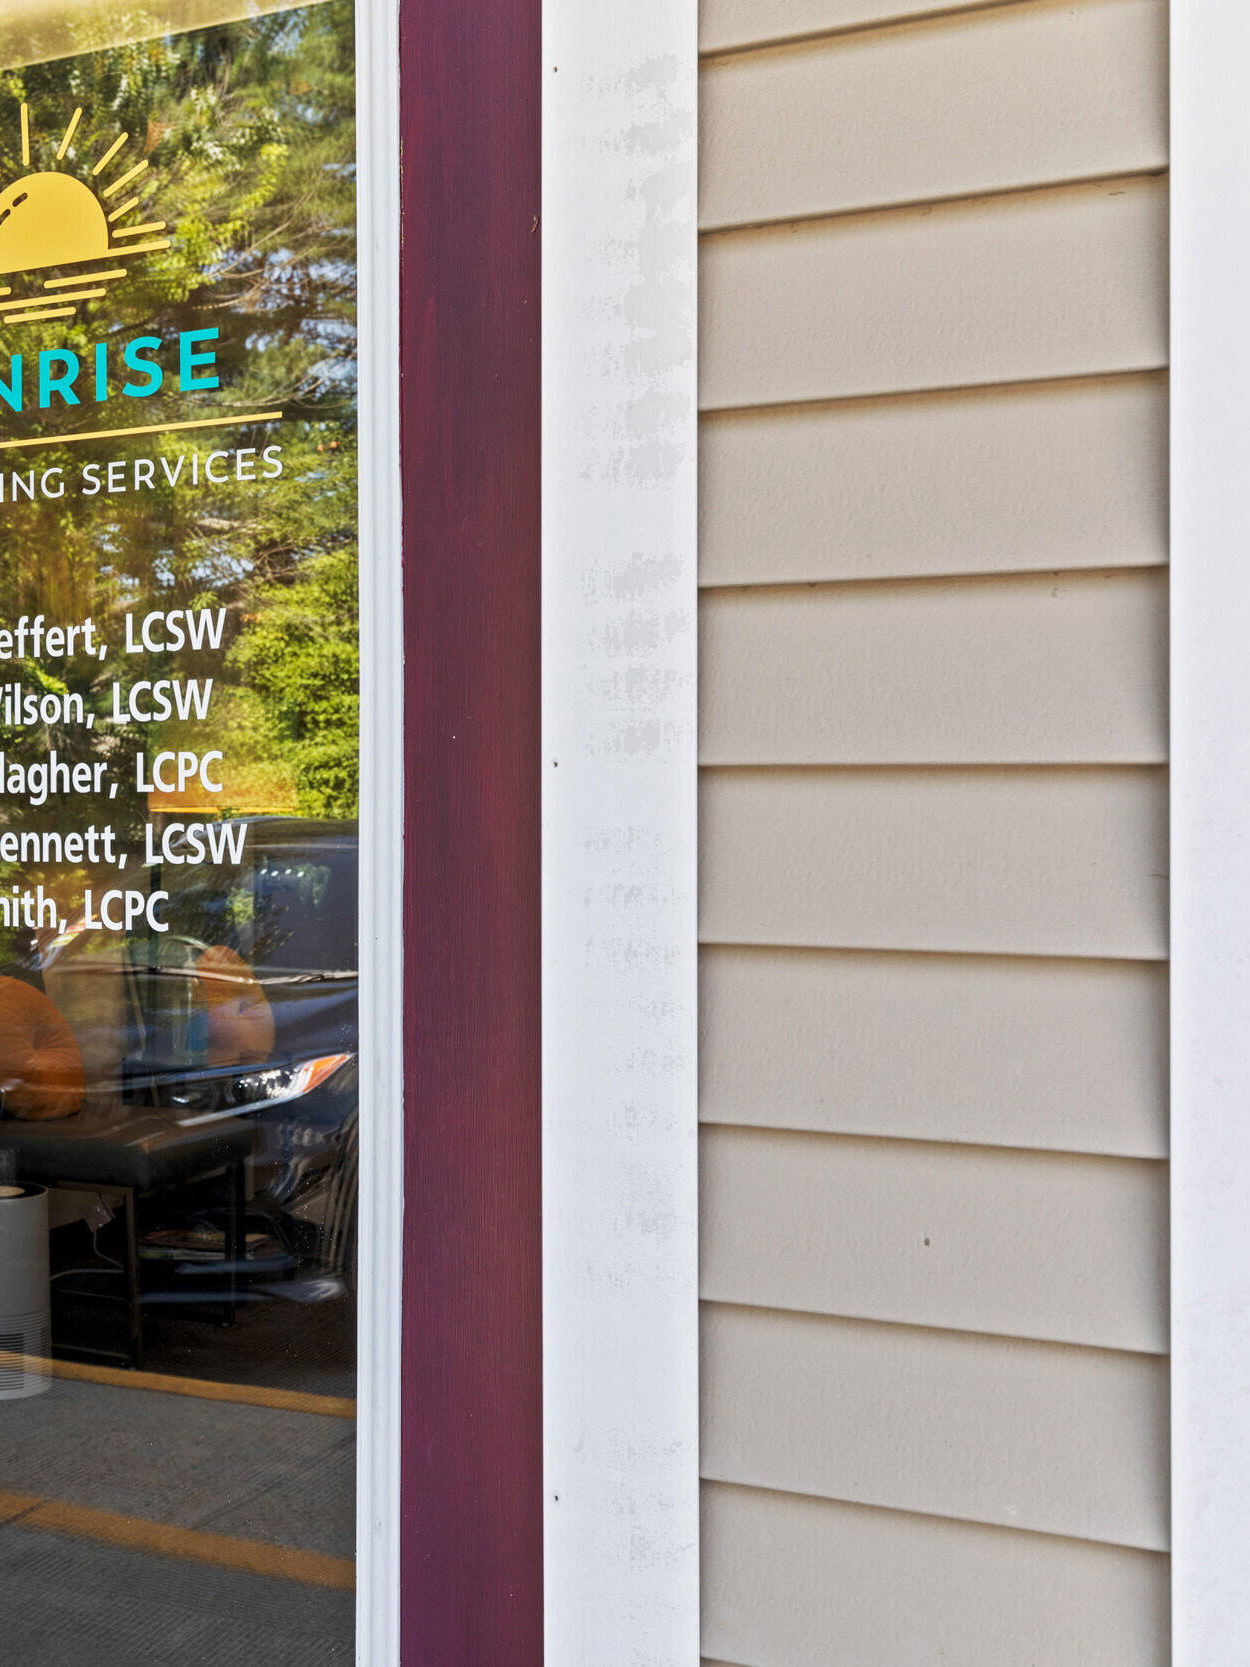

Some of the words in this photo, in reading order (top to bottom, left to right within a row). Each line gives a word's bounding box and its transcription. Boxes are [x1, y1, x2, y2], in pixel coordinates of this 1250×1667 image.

[81, 445, 283, 495] SERVICES
[125, 607, 227, 654] LCSW
[112, 678, 214, 724] LCSW
[136, 750, 223, 793] LCPC
[144, 822, 248, 865] LCSW
[84, 889, 169, 932] LCPC
